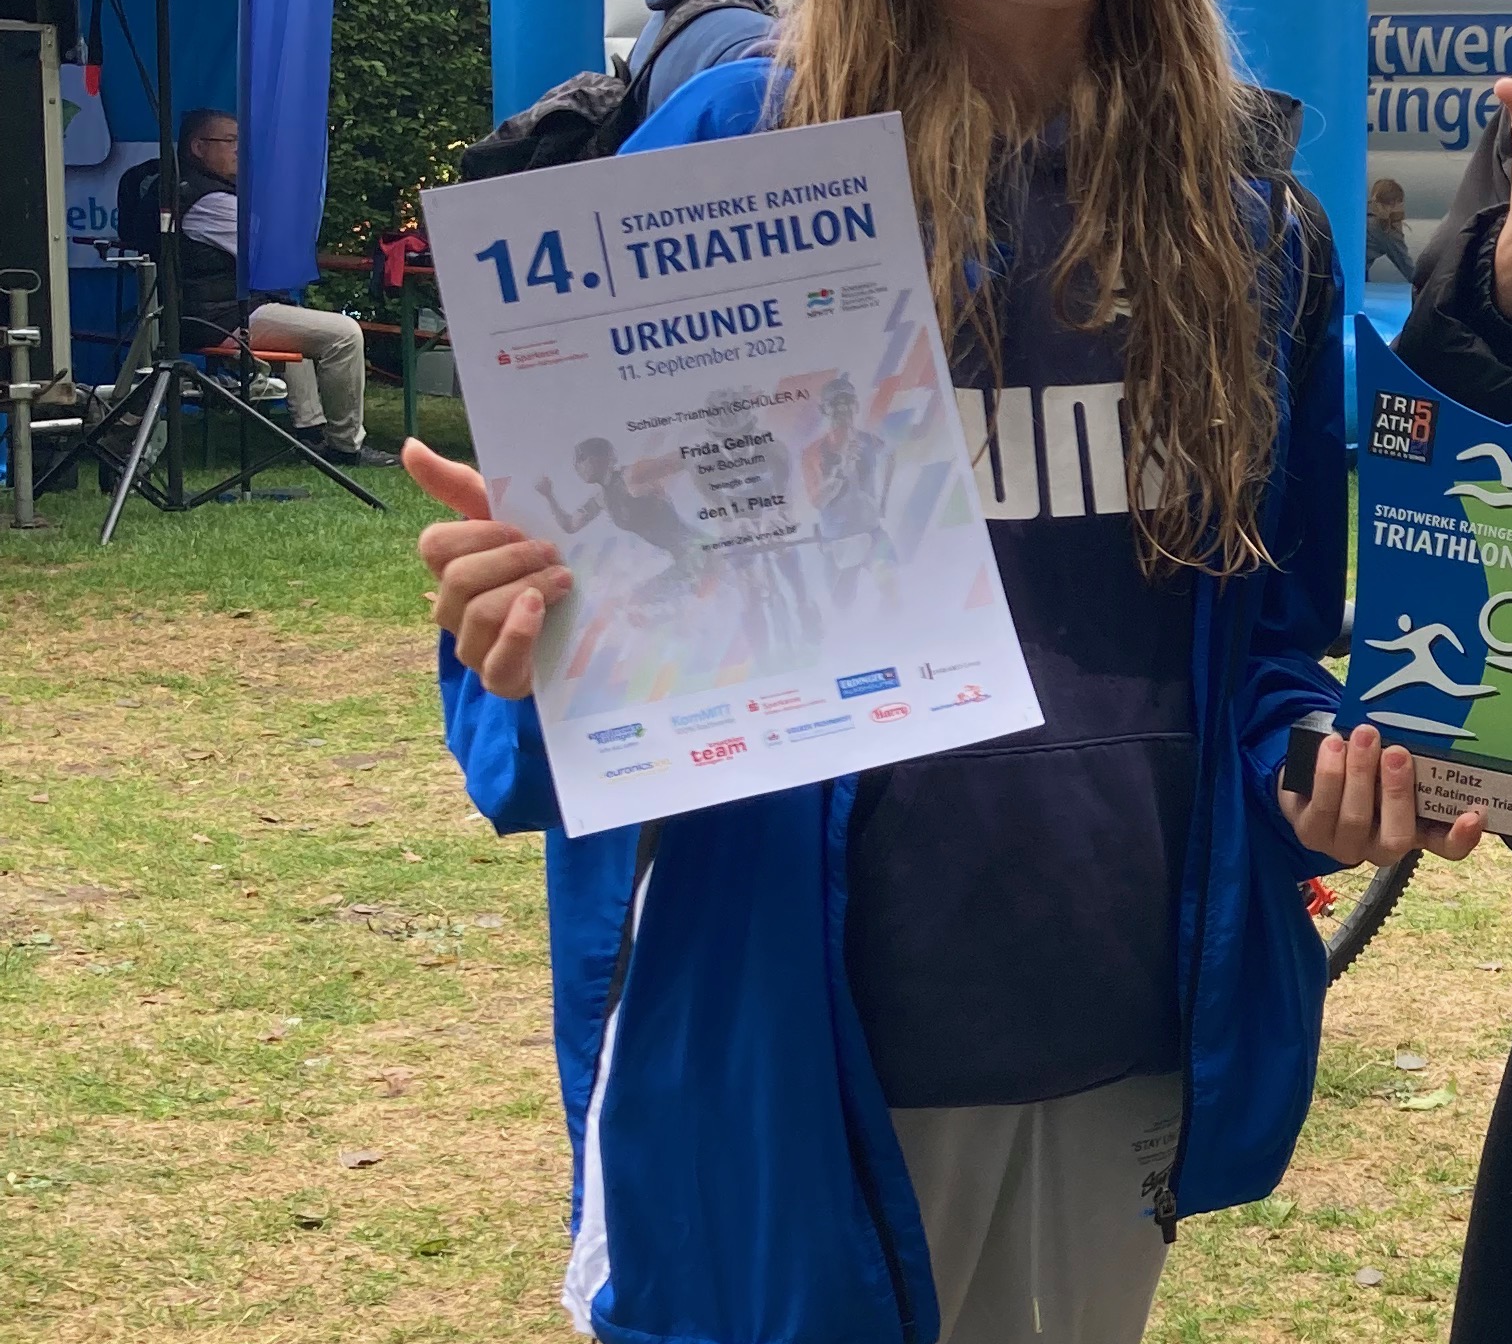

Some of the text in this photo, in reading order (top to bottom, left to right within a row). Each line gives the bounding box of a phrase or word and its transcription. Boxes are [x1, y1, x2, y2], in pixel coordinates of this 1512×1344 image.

[621, 176, 869, 234] STADTWERKE RATINGEN
[626, 203, 877, 280] TRIATHLON
[475, 230, 601, 304] 14.
[609, 299, 784, 356] URKUNDE
[617, 336, 787, 381] 11. September 2022
[1379, 393, 1415, 414] TRI
[1376, 413, 1413, 434] ATH
[680, 442, 720, 460] Frida
[1373, 432, 1410, 453] LON
[717, 454, 766, 471] Bochum
[698, 505, 728, 521] den
[749, 493, 786, 511] Platz
[1374, 504, 1457, 532] STADTWERKE
[690, 740, 748, 763] team
[1430, 766, 1483, 789] 1. Platz
[1434, 784, 1490, 808] Ratingen
